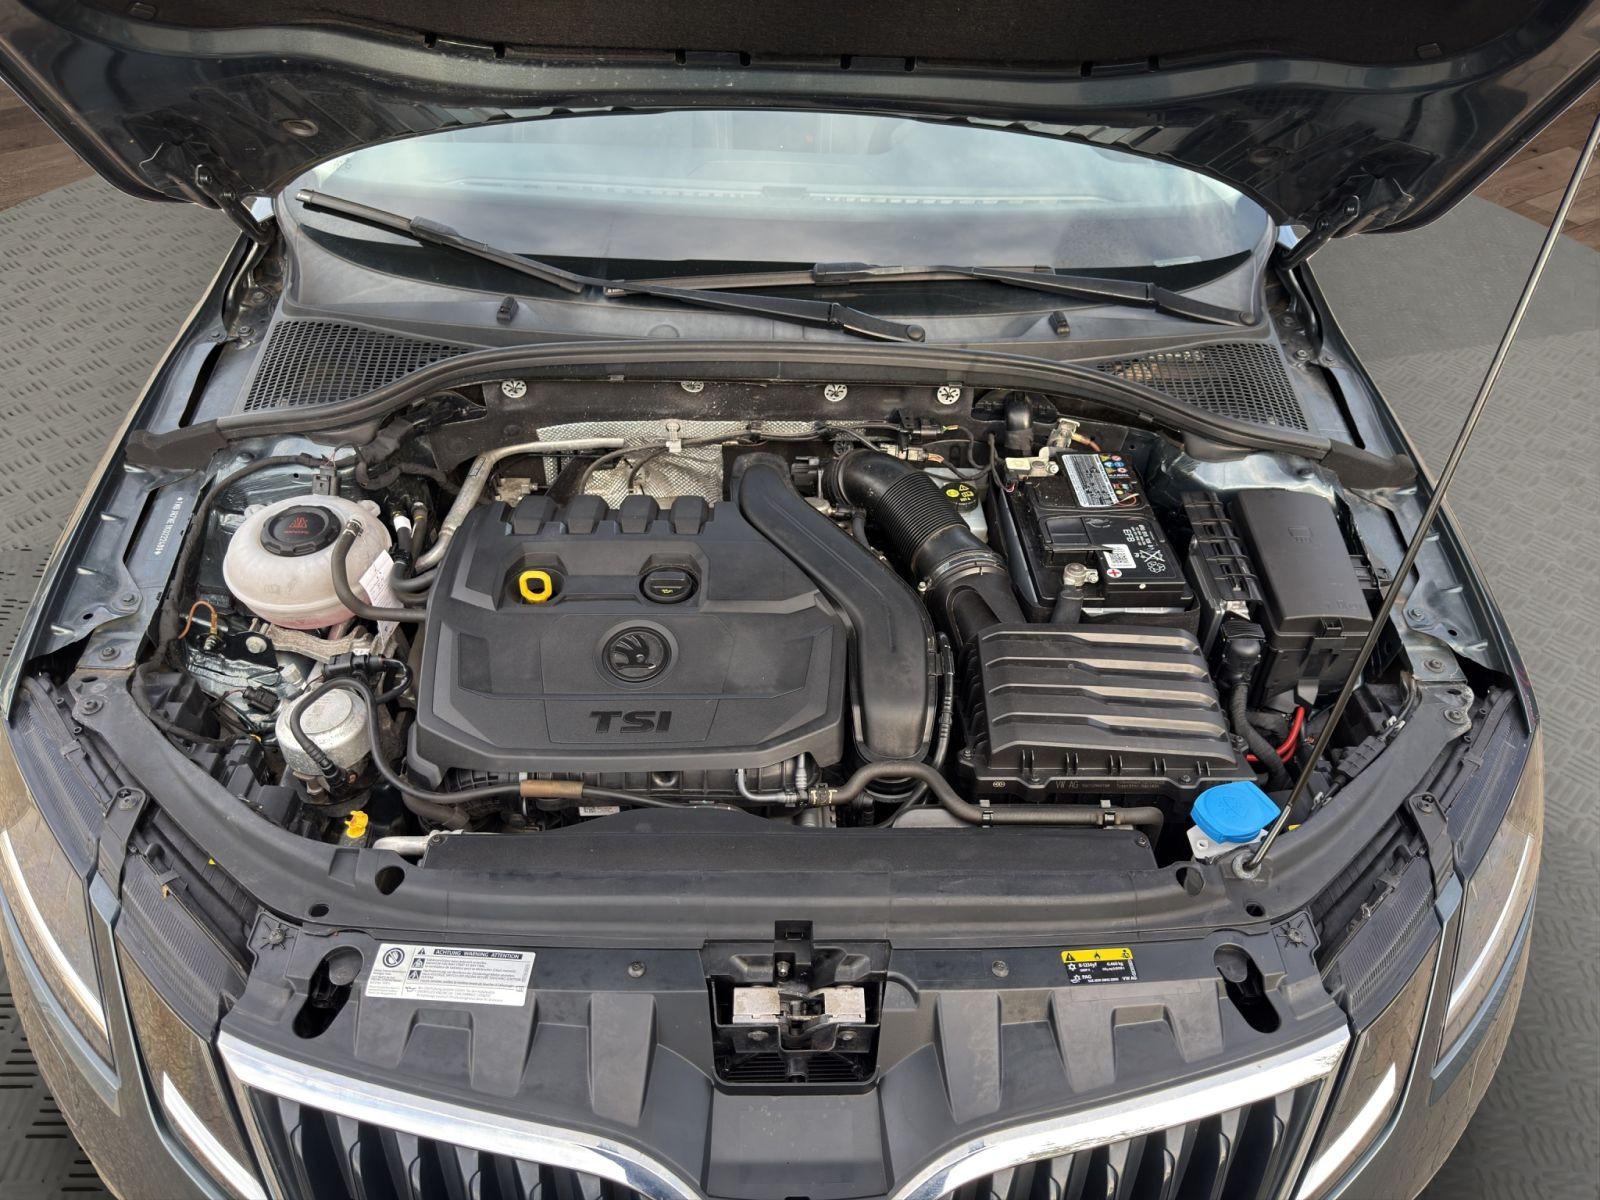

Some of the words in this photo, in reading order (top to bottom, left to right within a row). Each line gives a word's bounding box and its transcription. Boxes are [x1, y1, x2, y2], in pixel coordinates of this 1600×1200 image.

[1123, 529, 1136, 542] EFB
[590, 711, 672, 733] TSI
[1055, 780, 1066, 789] VW
[1069, 780, 1079, 789] AG
